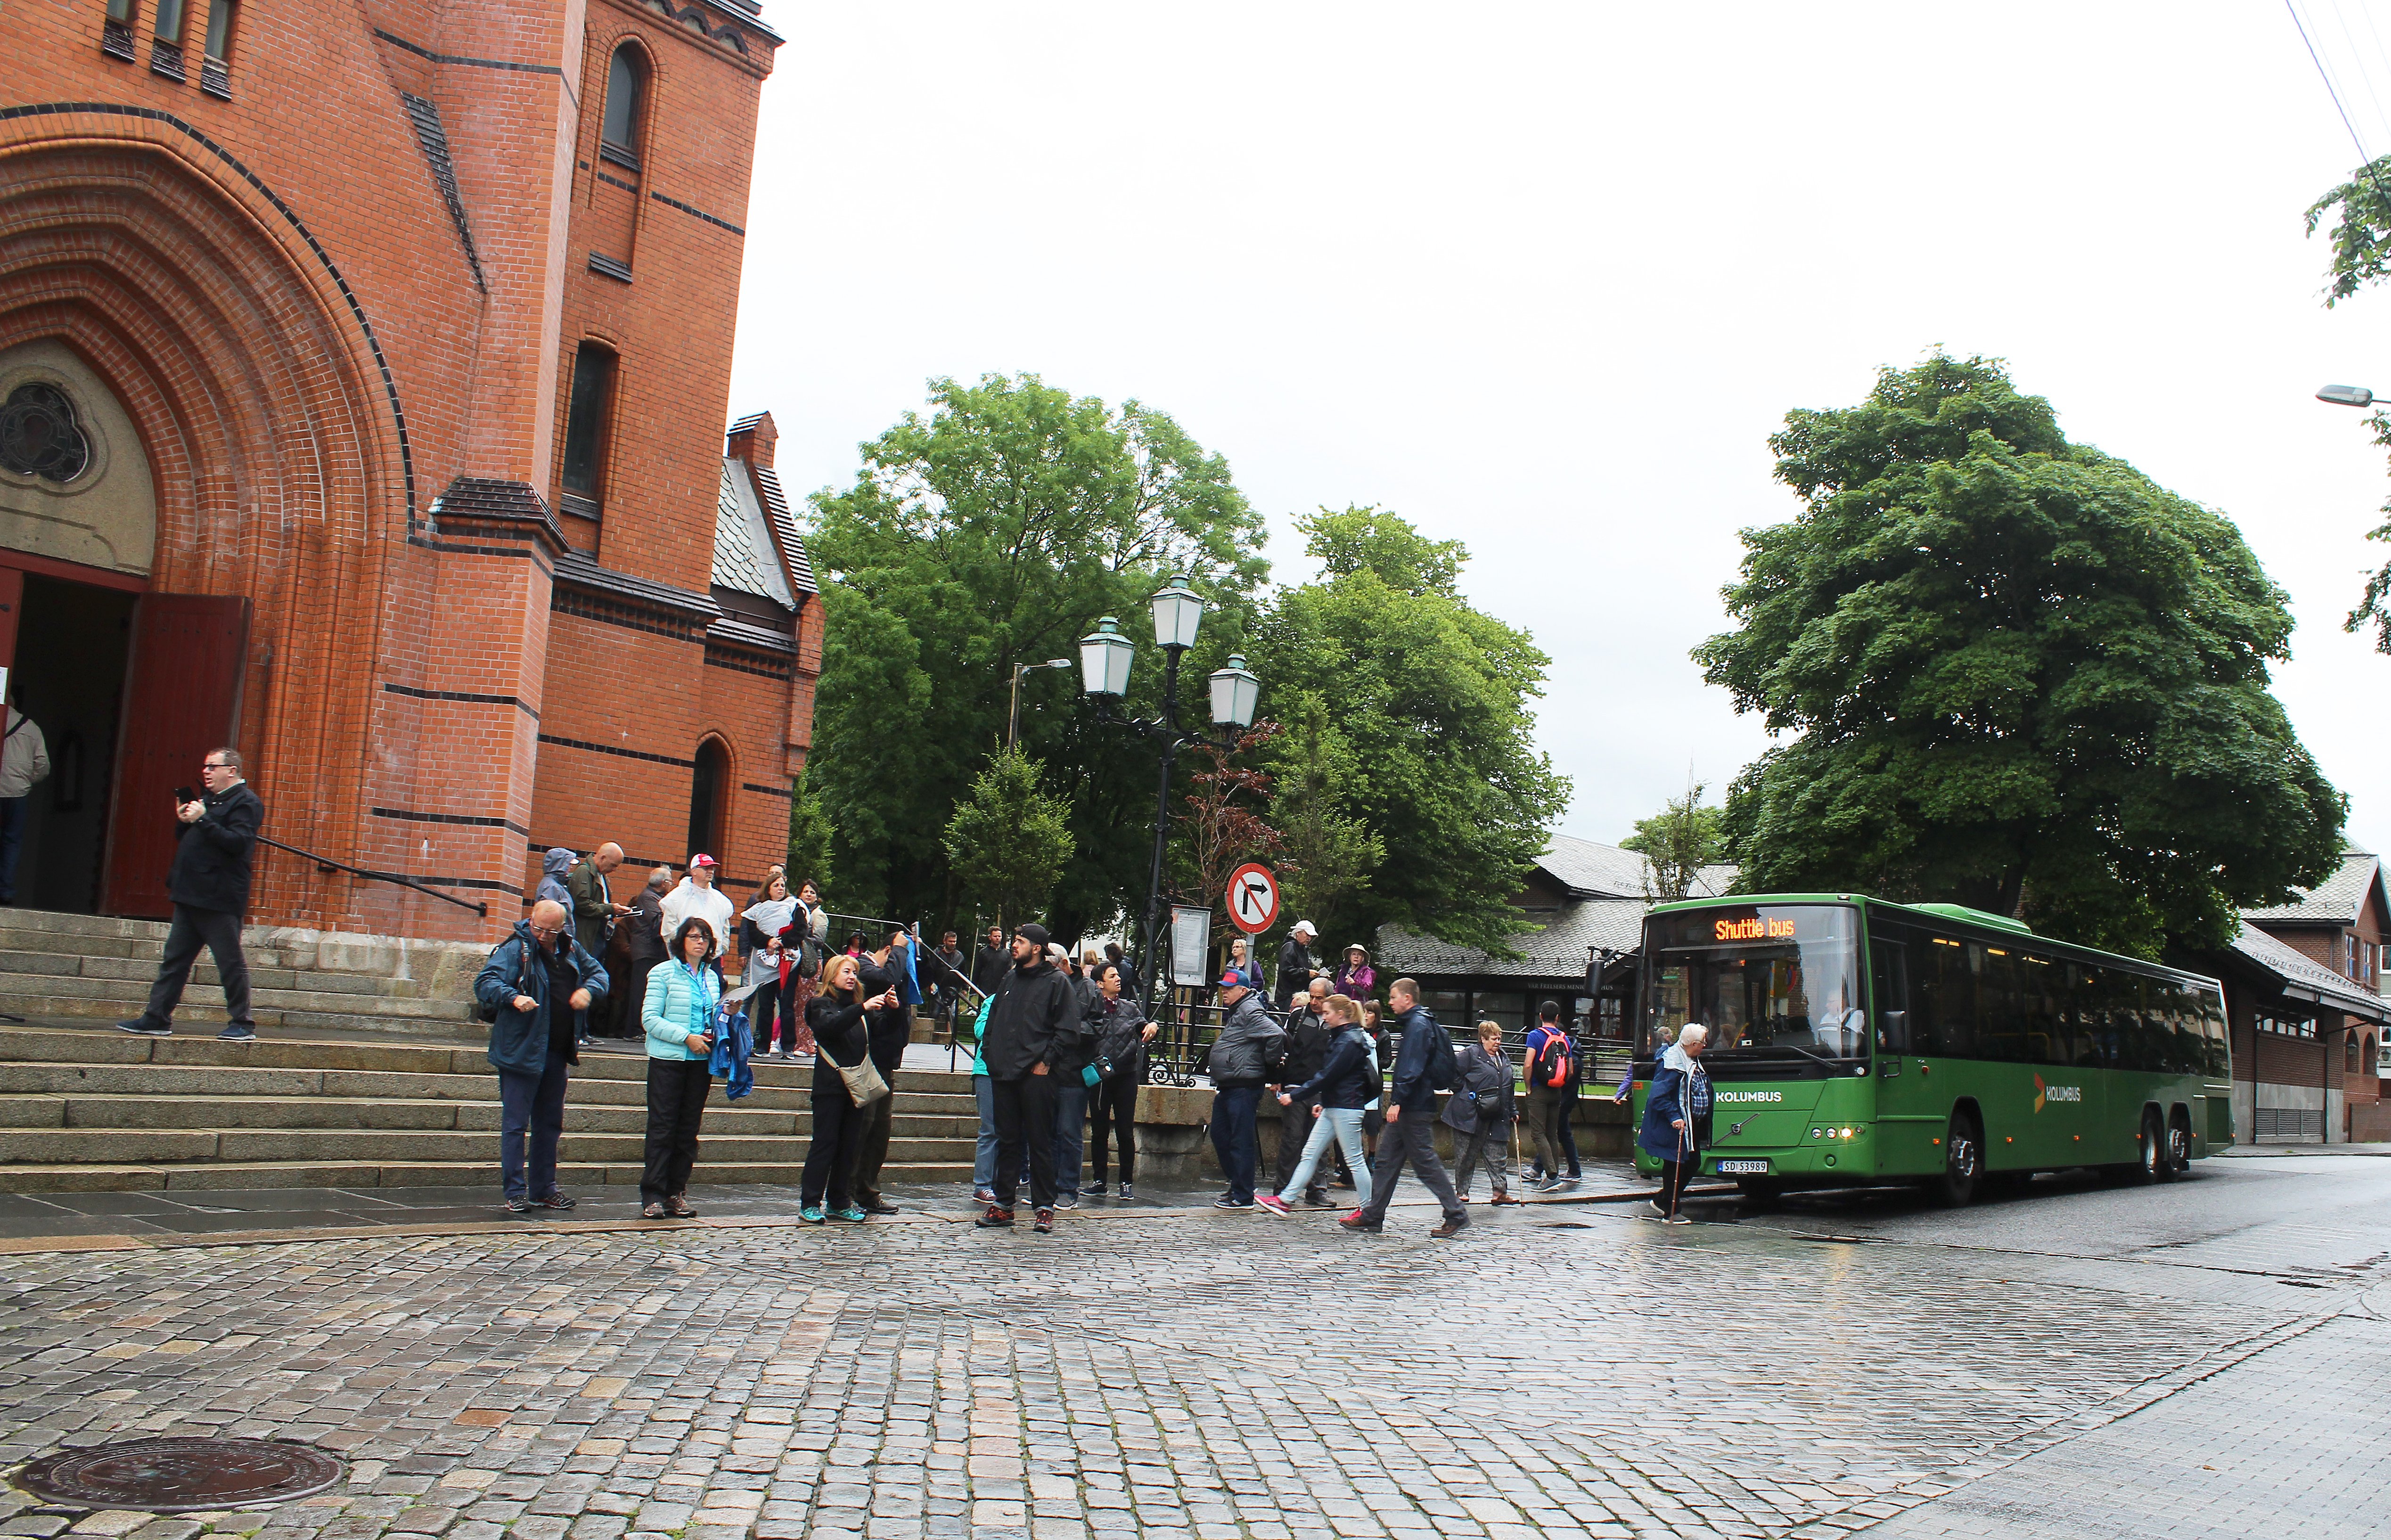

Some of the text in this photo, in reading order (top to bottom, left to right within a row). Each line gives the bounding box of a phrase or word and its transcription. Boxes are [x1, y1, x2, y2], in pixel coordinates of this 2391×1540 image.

[1716, 917, 1795, 940] Shuttle bus
[1715, 1091, 1782, 1103] KOLUMBUS
[2046, 1086, 2080, 1102] KOLUMBUS
[1725, 1162, 1766, 1171] SD 53989
